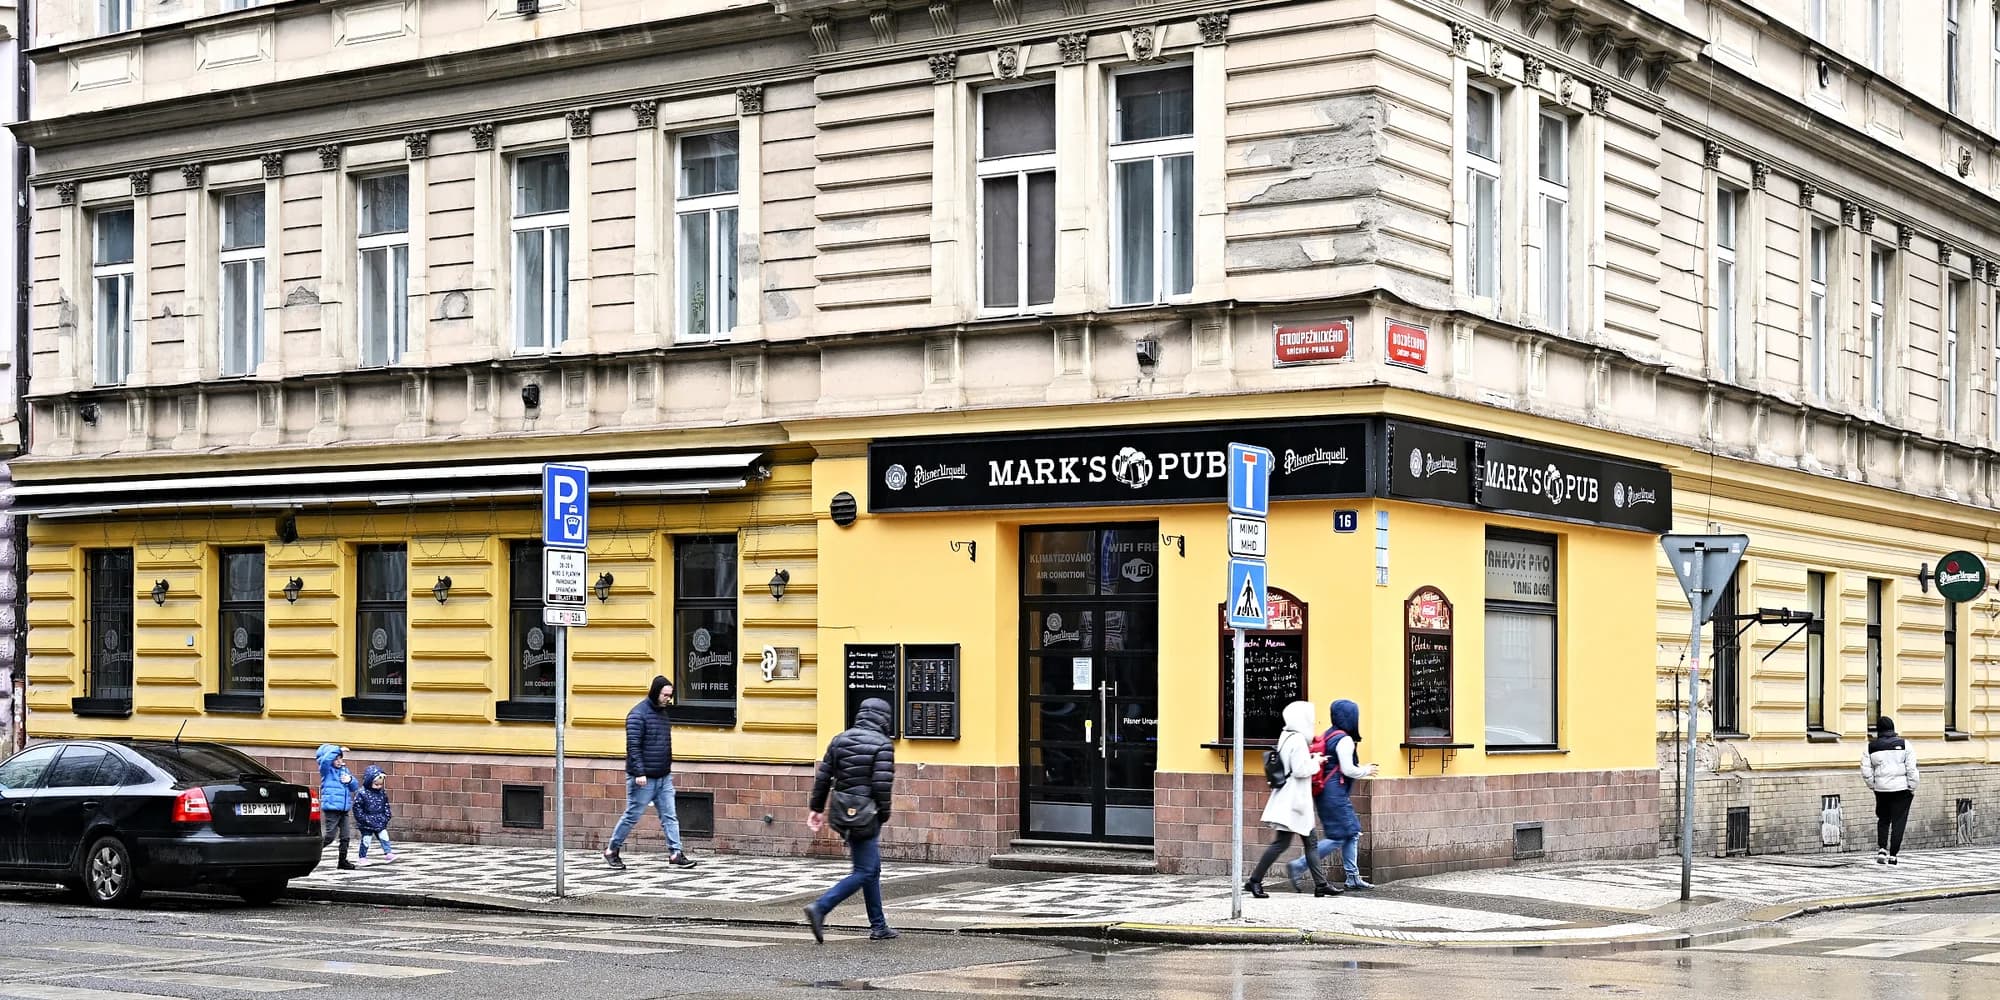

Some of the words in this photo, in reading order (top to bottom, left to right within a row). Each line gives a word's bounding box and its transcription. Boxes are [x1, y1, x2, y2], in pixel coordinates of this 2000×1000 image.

[1279, 329, 1344, 346] STROUPEŽNICKÉHO
[988, 456, 1107, 486] MARK'S
[1158, 450, 1227, 480] PUB
[1284, 449, 1316, 475] Pilsner
[1315, 447, 1349, 466] Urquell
[914, 464, 940, 489] Pilsner
[940, 463, 968, 481] Urquell
[1485, 460, 1542, 495] MARK'S
[1565, 477, 1599, 503] PUB
[554, 475, 579, 520] P
[1338, 514, 1351, 528] 16
[1239, 524, 1259, 536] MIMO
[1109, 543, 1134, 553] WIFI
[1241, 540, 1257, 551] MHD
[1030, 552, 1092, 564] KLIMATIZOVÁNO
[1529, 554, 1550, 572] PIVO
[1037, 571, 1048, 579] AIR
[1049, 571, 1085, 579] CONDITION
[1513, 581, 1532, 595] TANK
[688, 651, 711, 672] Pilsner
[710, 650, 733, 667] Urquell
[371, 677, 385, 685] WIFI
[691, 682, 708, 691] WIFI
[709, 682, 729, 691] FREE
